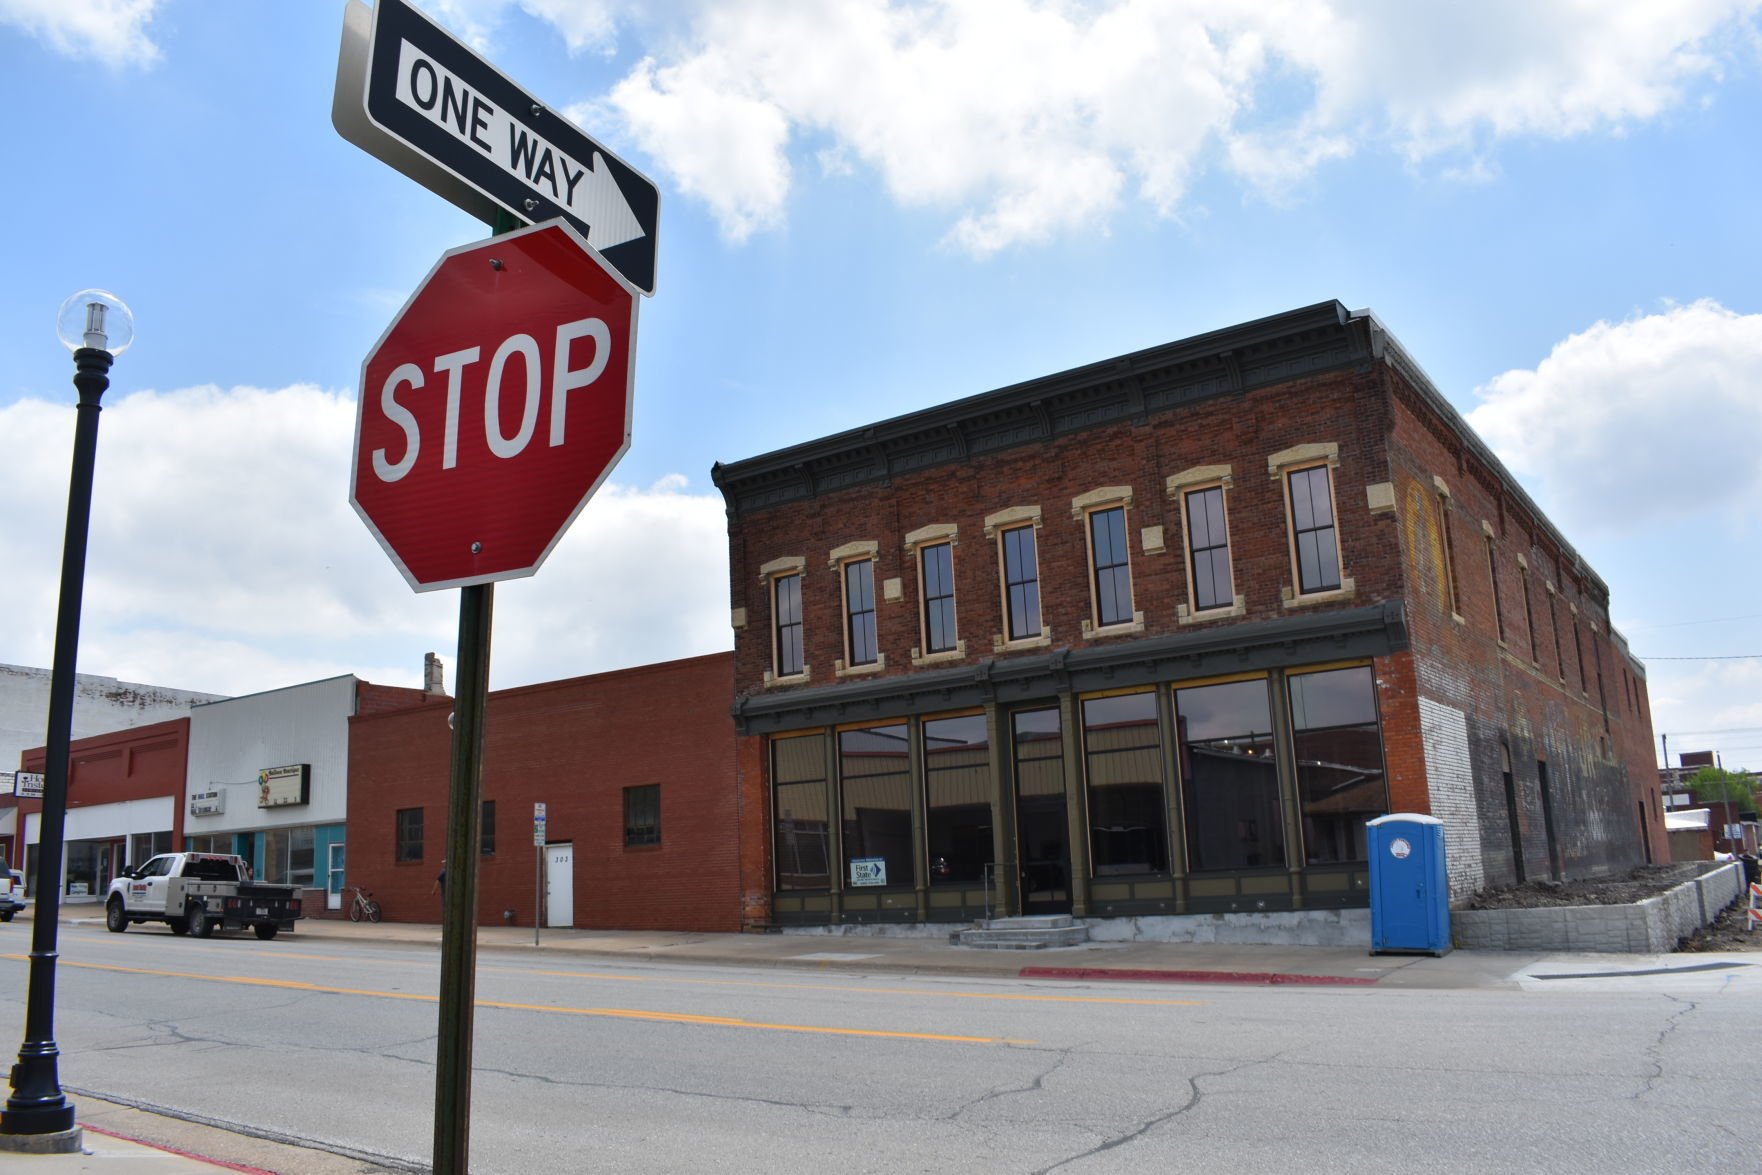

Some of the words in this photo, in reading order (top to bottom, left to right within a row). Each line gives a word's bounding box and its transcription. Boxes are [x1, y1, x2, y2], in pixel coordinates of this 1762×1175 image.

[410, 58, 494, 154] ONE
[510, 122, 585, 207] WAY
[372, 317, 612, 483] STOP
